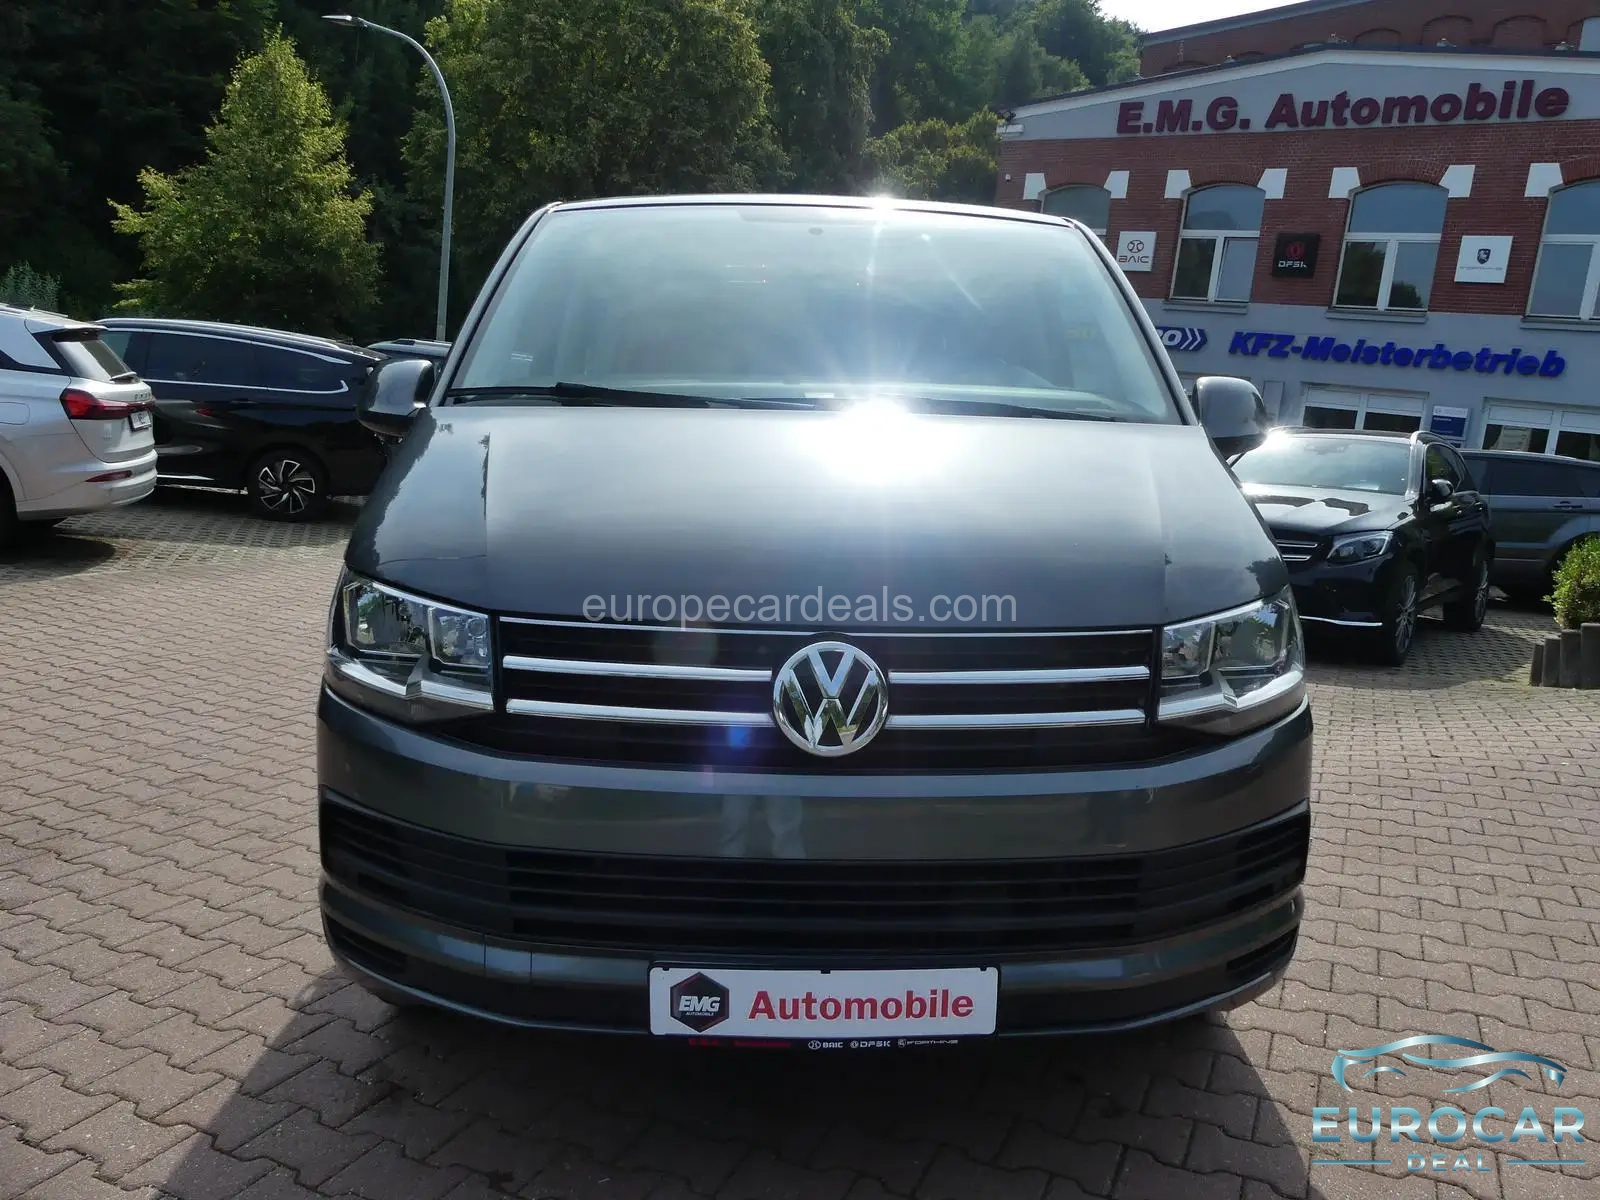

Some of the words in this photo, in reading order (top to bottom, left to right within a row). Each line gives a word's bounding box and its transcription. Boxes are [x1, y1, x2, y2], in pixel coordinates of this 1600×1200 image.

[1116, 96, 1250, 134] E.M.G.
[1265, 80, 1570, 129] Automobile
[1229, 331, 1566, 378] KFZ-Meisterbetrieb
[679, 995, 721, 1012] EMG
[748, 988, 974, 1021] Automobile
[822, 1041, 844, 1049] BAIC
